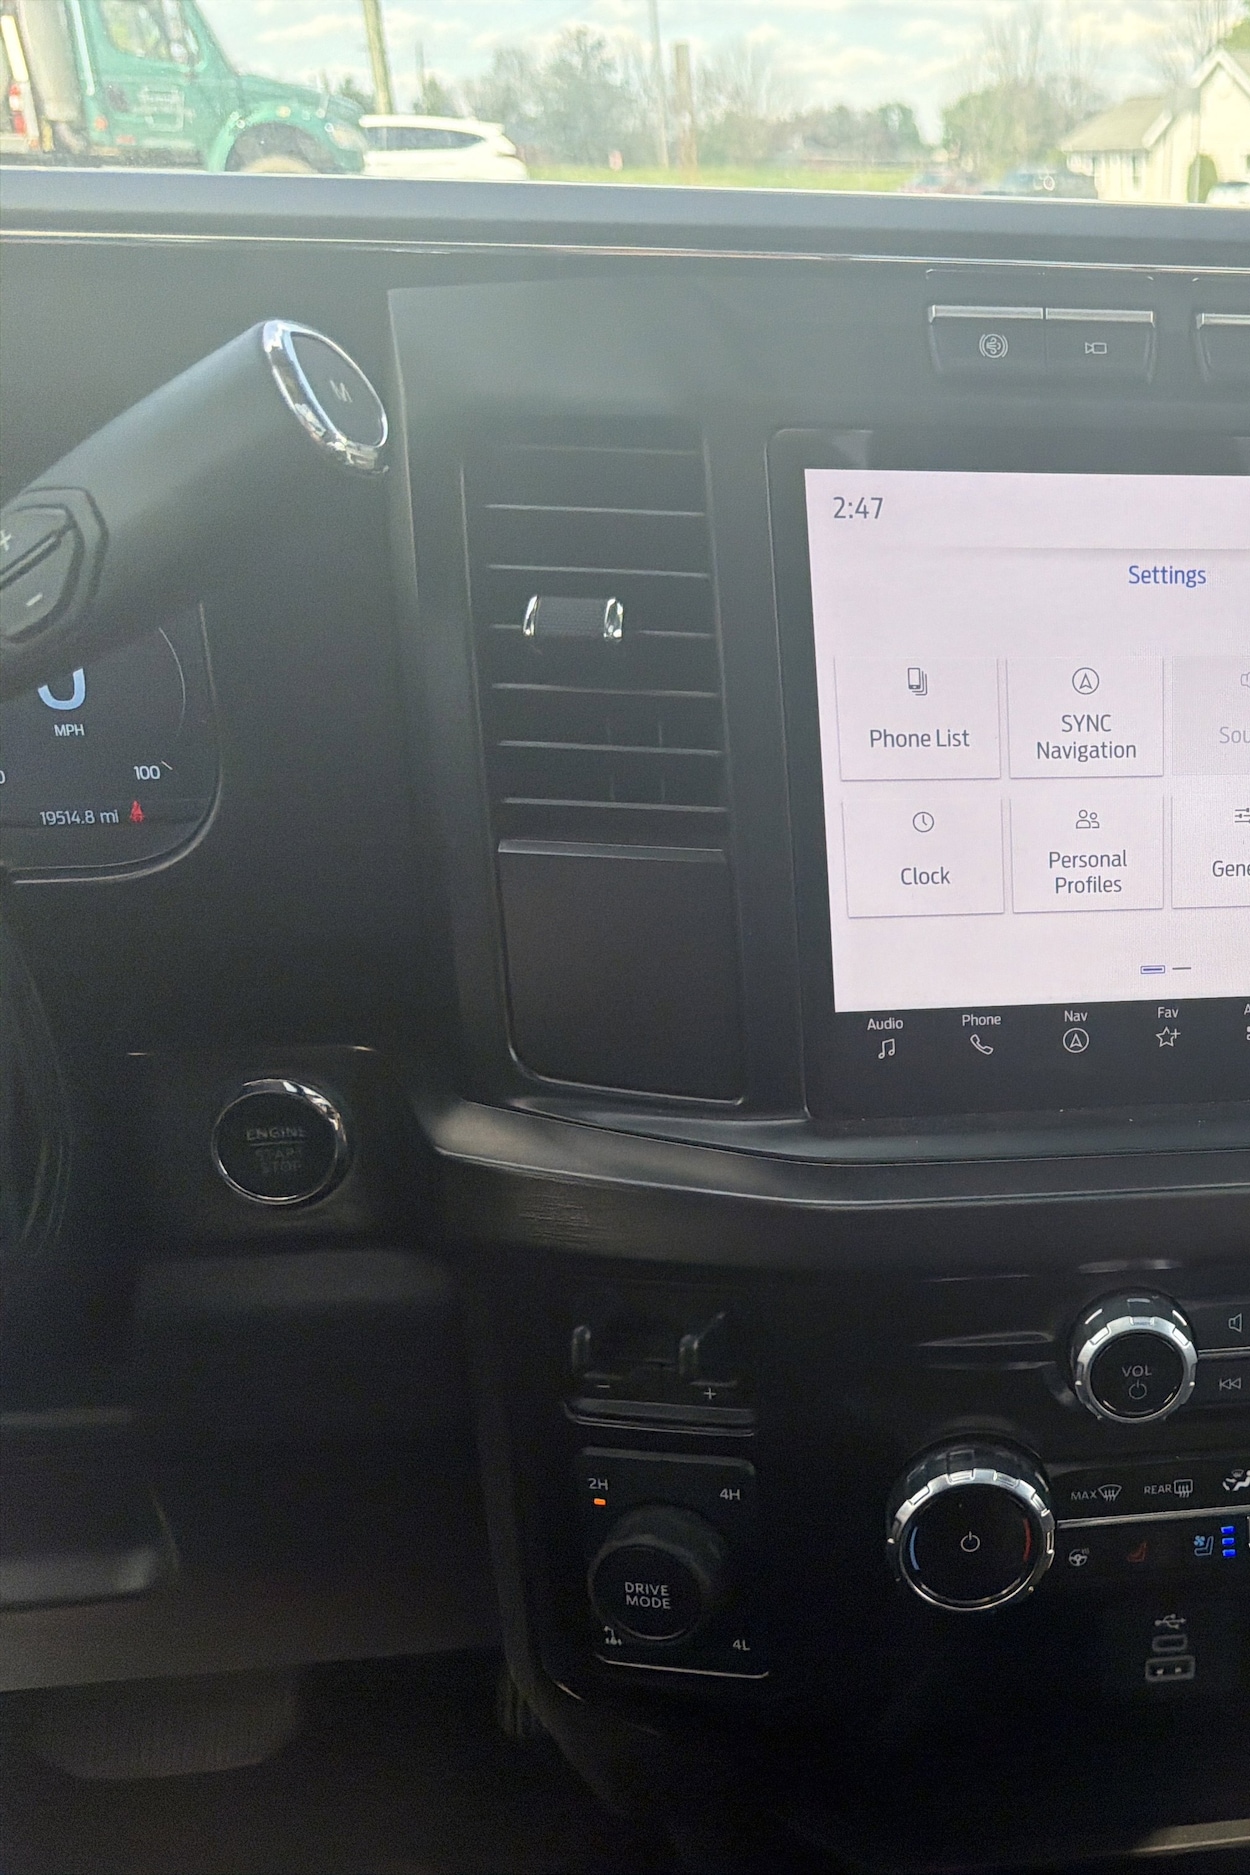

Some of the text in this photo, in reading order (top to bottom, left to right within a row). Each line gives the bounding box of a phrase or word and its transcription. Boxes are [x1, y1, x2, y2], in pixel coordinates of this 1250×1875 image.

[832, 496, 884, 520] 2:47
[1127, 564, 1206, 587] Settings
[54, 724, 84, 736] MPH
[1060, 713, 1112, 733] SYNC
[868, 727, 970, 748] Phone List
[1035, 740, 1137, 763] Navigation
[133, 765, 160, 780] 100
[40, 809, 118, 825] 19514.8 mi
[1048, 849, 1127, 869] Personal
[899, 866, 951, 886] Clock
[1054, 875, 1122, 895] Profiles
[961, 1012, 1001, 1027] Phone
[1063, 1009, 1088, 1022] Nav
[1156, 1006, 1179, 1019] Fav
[867, 1016, 903, 1031] Audio
[1121, 1364, 1152, 1378] VOL
[588, 1477, 609, 1491] 2H
[1143, 1482, 1172, 1495] REAR
[719, 1488, 741, 1501] 4H
[1070, 1488, 1097, 1501] MAX
[624, 1581, 669, 1597] DRIVE
[625, 1594, 671, 1610] MODE
[732, 1639, 750, 1651] 4L
